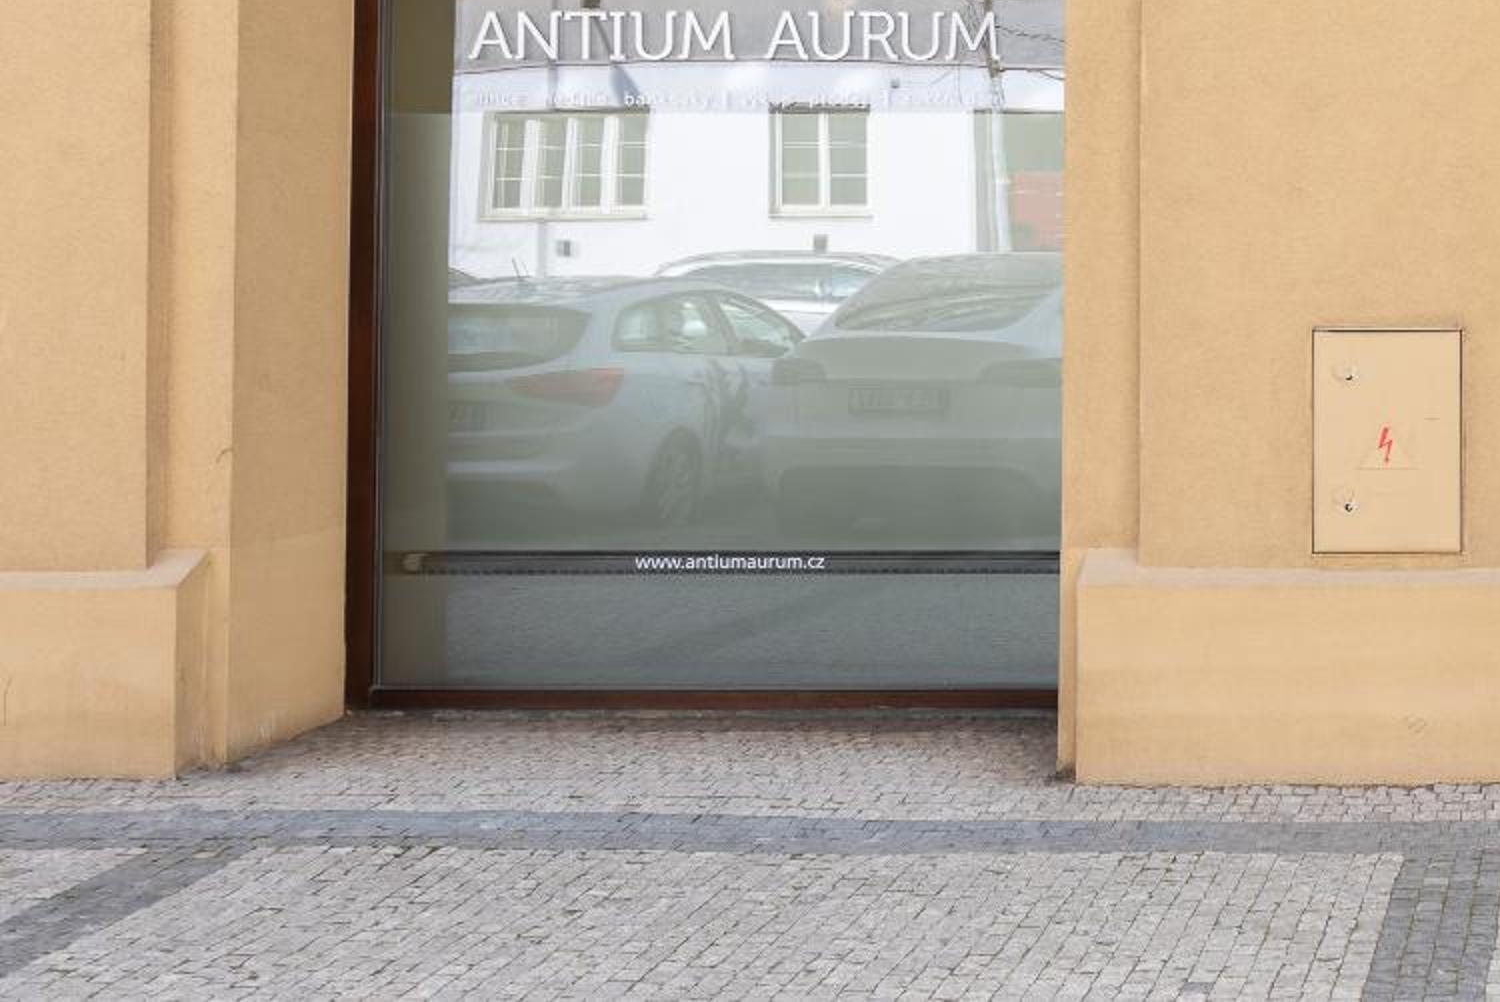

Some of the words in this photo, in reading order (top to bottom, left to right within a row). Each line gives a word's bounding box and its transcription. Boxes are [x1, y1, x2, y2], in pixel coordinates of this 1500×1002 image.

[468, 10, 736, 61] ANTIUM
[763, 10, 1001, 61] AURUM
[635, 553, 825, 570] www.antiumaurum.cz
